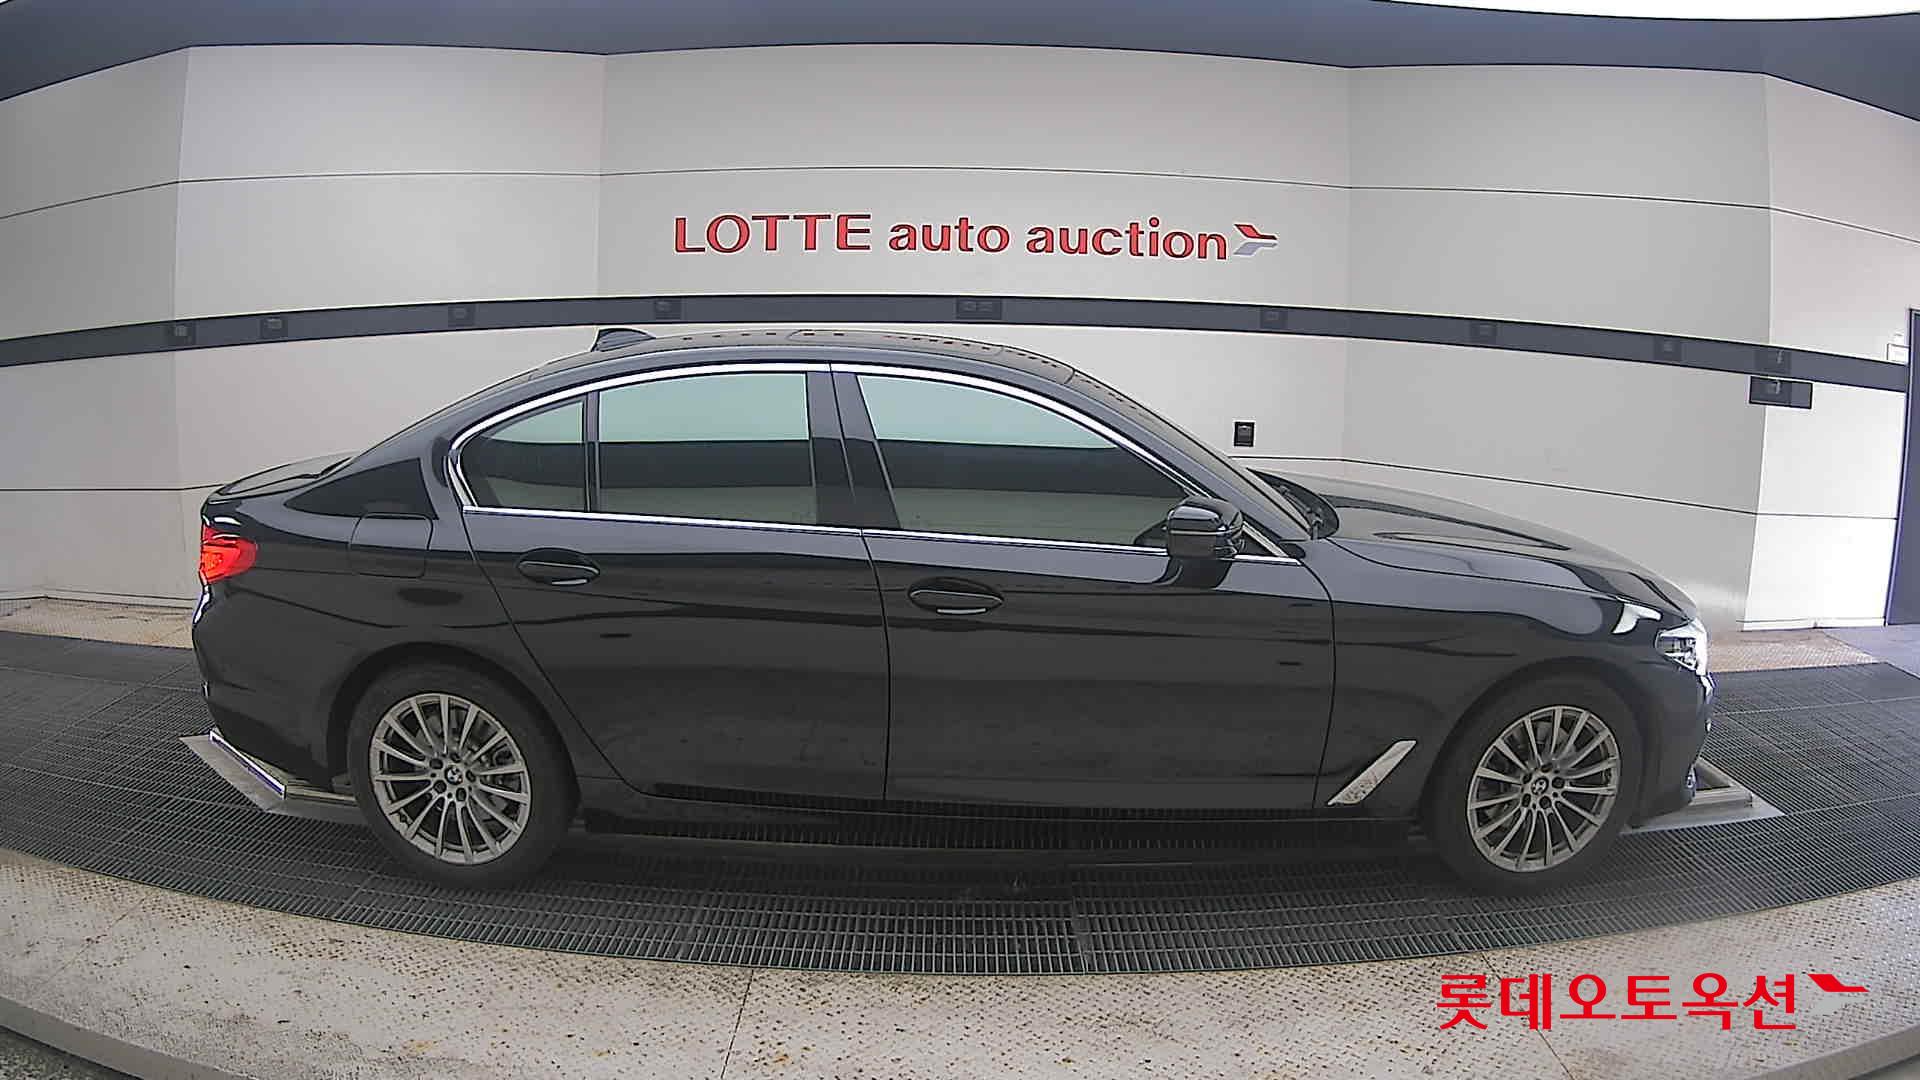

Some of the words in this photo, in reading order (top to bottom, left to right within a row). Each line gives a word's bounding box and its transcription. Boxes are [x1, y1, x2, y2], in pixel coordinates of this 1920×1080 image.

[674, 214, 872, 254] LOTTE
[888, 217, 1011, 253] auto
[1026, 217, 1228, 260] auction
